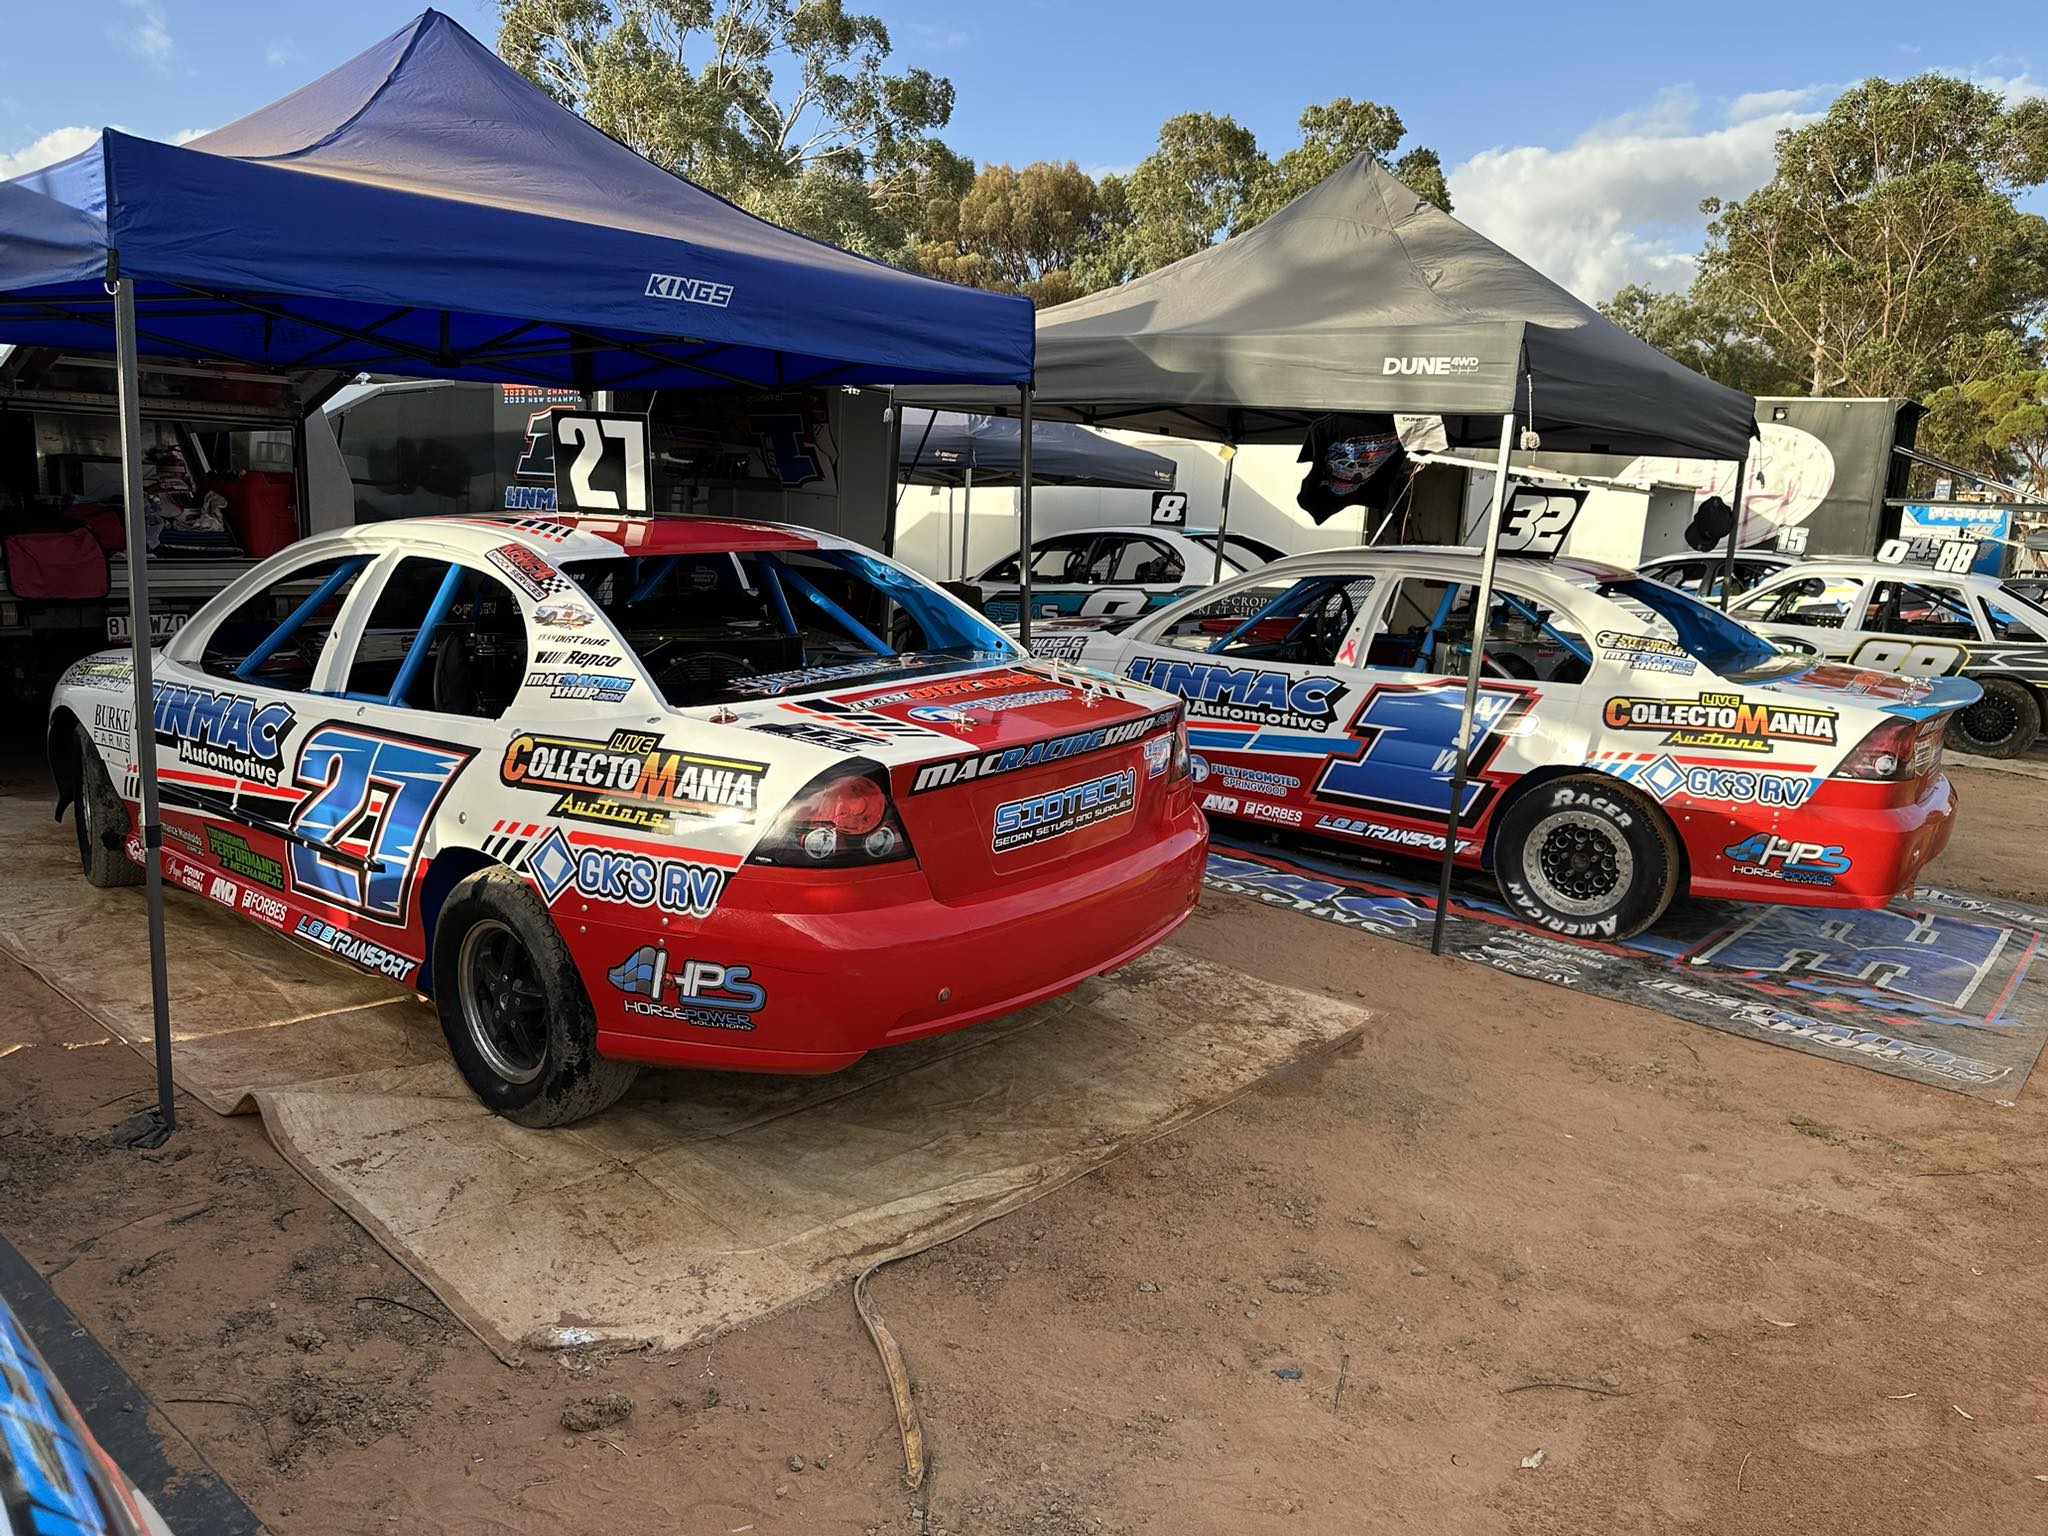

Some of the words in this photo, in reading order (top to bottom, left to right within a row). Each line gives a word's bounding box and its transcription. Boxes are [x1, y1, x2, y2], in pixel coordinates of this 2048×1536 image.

[645, 273, 734, 308] KINGS
[1382, 357, 1450, 375] DUNE
[1450, 356, 1479, 367] 4WD
[557, 416, 647, 512] 27
[1152, 494, 1184, 523] 8
[1500, 493, 1579, 551] 32
[1776, 526, 1810, 555] 15
[1933, 541, 1980, 573] 88
[510, 568, 545, 598] SERVICES
[555, 635, 583, 643] DIRT
[581, 638, 610, 647] DOG
[525, 673, 636, 693] MACRACING
[1126, 657, 1346, 716] LINMAC
[1700, 692, 1741, 707] LIVE
[95, 704, 131, 733] BURKE
[1190, 703, 1328, 732] Automotive
[1603, 697, 1834, 740] COLLECTOMANIA
[94, 732, 131, 750] FARMS
[608, 731, 656, 756] LIVE
[1310, 682, 1526, 822] 1
[181, 740, 278, 785] Automotive
[502, 736, 754, 808] COLLECTOMANIA
[1211, 764, 1242, 780] FULLY
[1242, 768, 1300, 788] PROMOTED
[1222, 777, 1288, 798] SPRINGWOOD
[1686, 768, 1757, 799] GK'S
[1762, 774, 1809, 806] RV
[1036, 818, 1075, 837] SETUPS
[1094, 799, 1133, 818] SUPPLIES
[1255, 803, 1303, 822] FORBES
[1553, 786, 1634, 829] RACER
[292, 718, 480, 928] 27
[183, 864, 206, 882] PRINT
[210, 838, 284, 880] PERFORMANCE
[1731, 864, 1835, 884] HORSEPOWER
[230, 860, 284, 890] MECHANICAL
[575, 848, 658, 902] GK'S
[661, 857, 722, 913] RV
[251, 892, 287, 922] FORBES
[1506, 880, 1619, 938] AMERICAN
[623, 999, 754, 1028] HORSEPOWER
